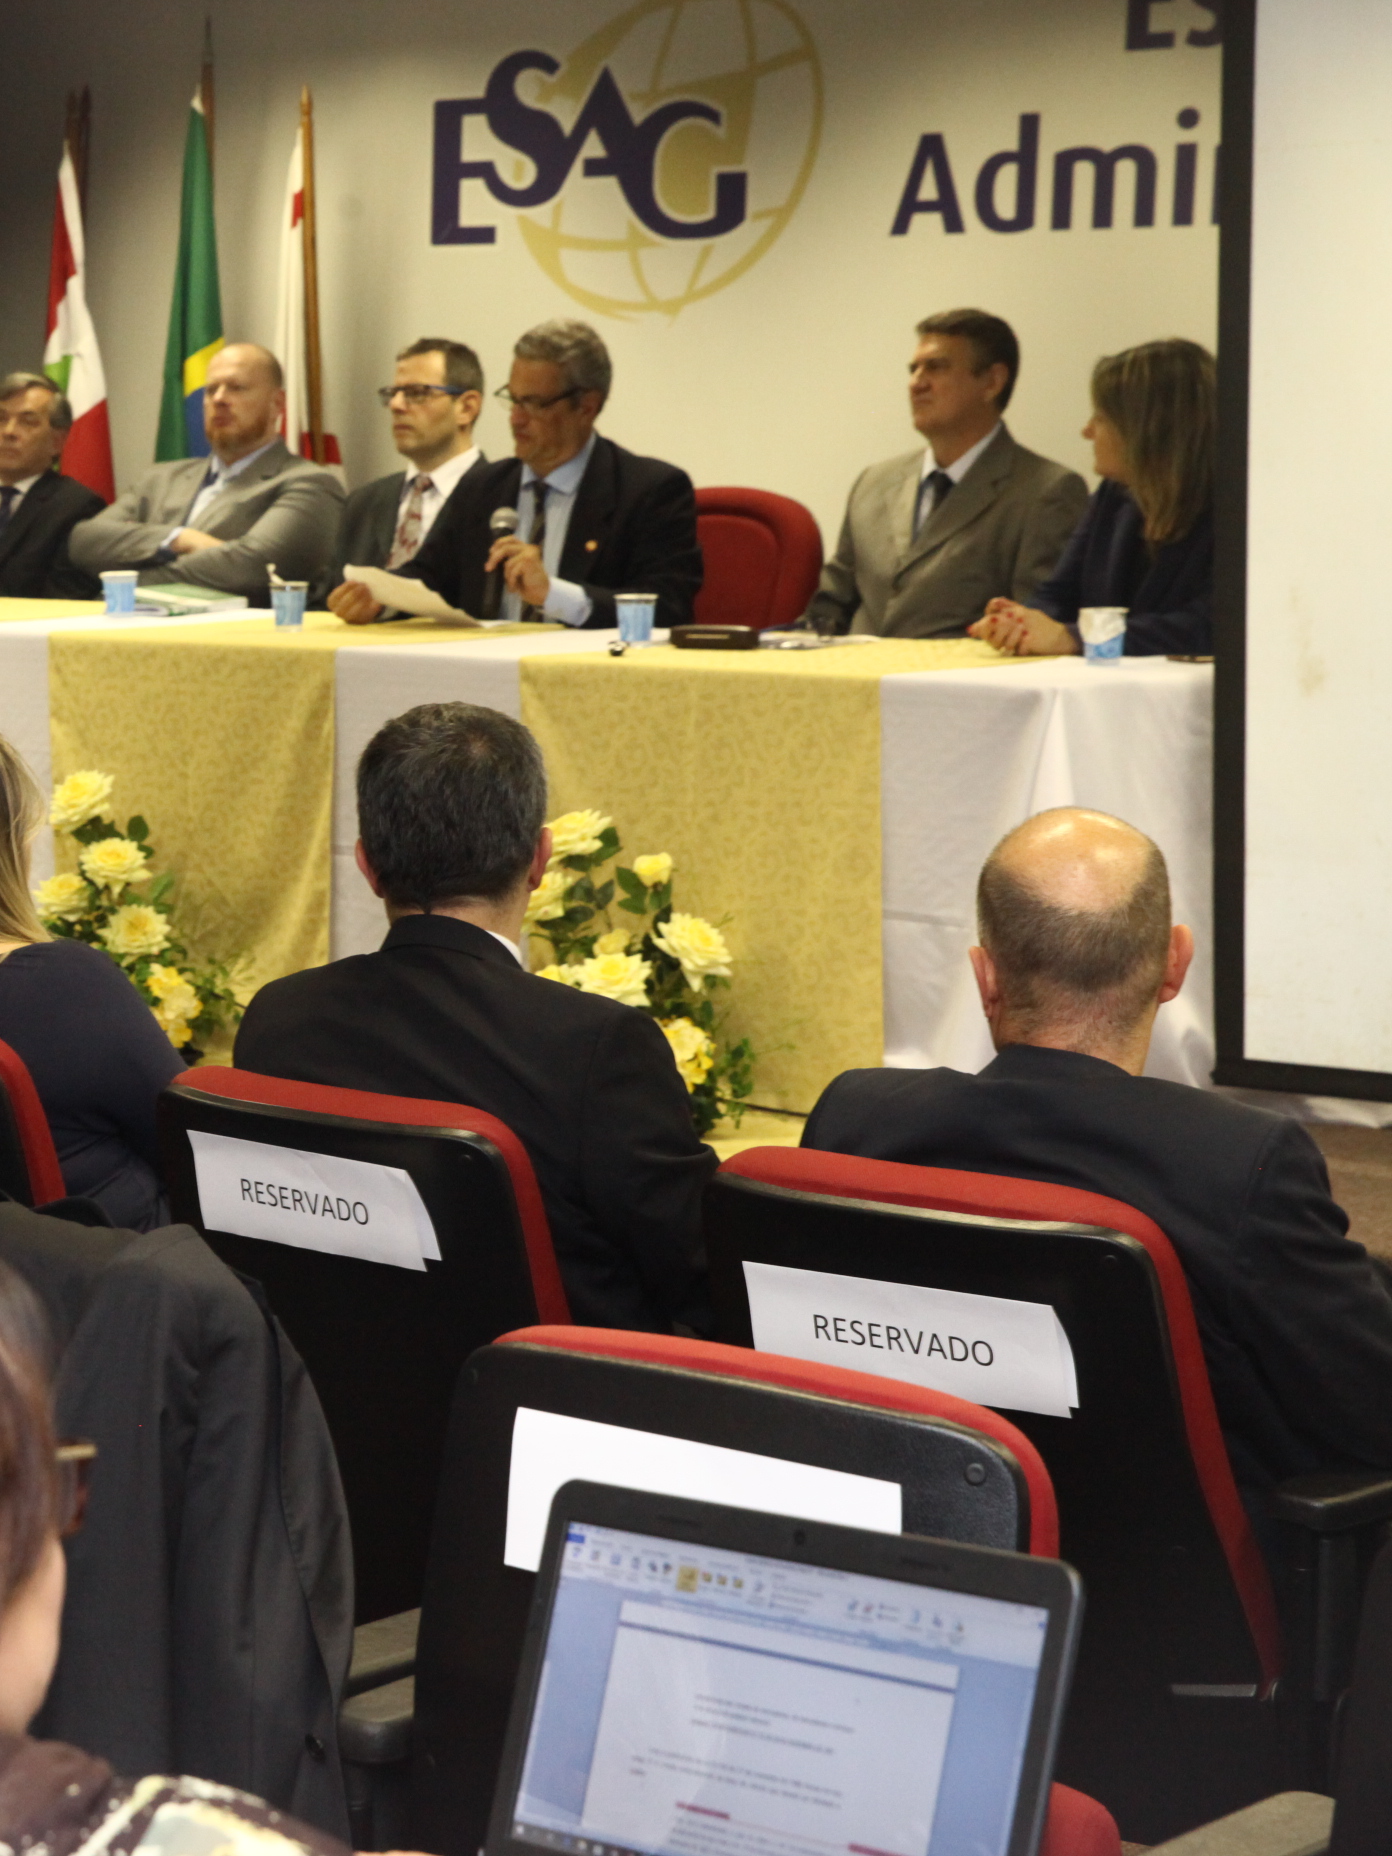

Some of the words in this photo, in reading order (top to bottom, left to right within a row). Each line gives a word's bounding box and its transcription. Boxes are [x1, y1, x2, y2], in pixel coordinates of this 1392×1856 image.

[431, 50, 747, 245] ESAG
[890, 106, 1220, 236] Admi
[240, 1178, 370, 1226] RESERVADO
[813, 1313, 995, 1368] RESERVADO
